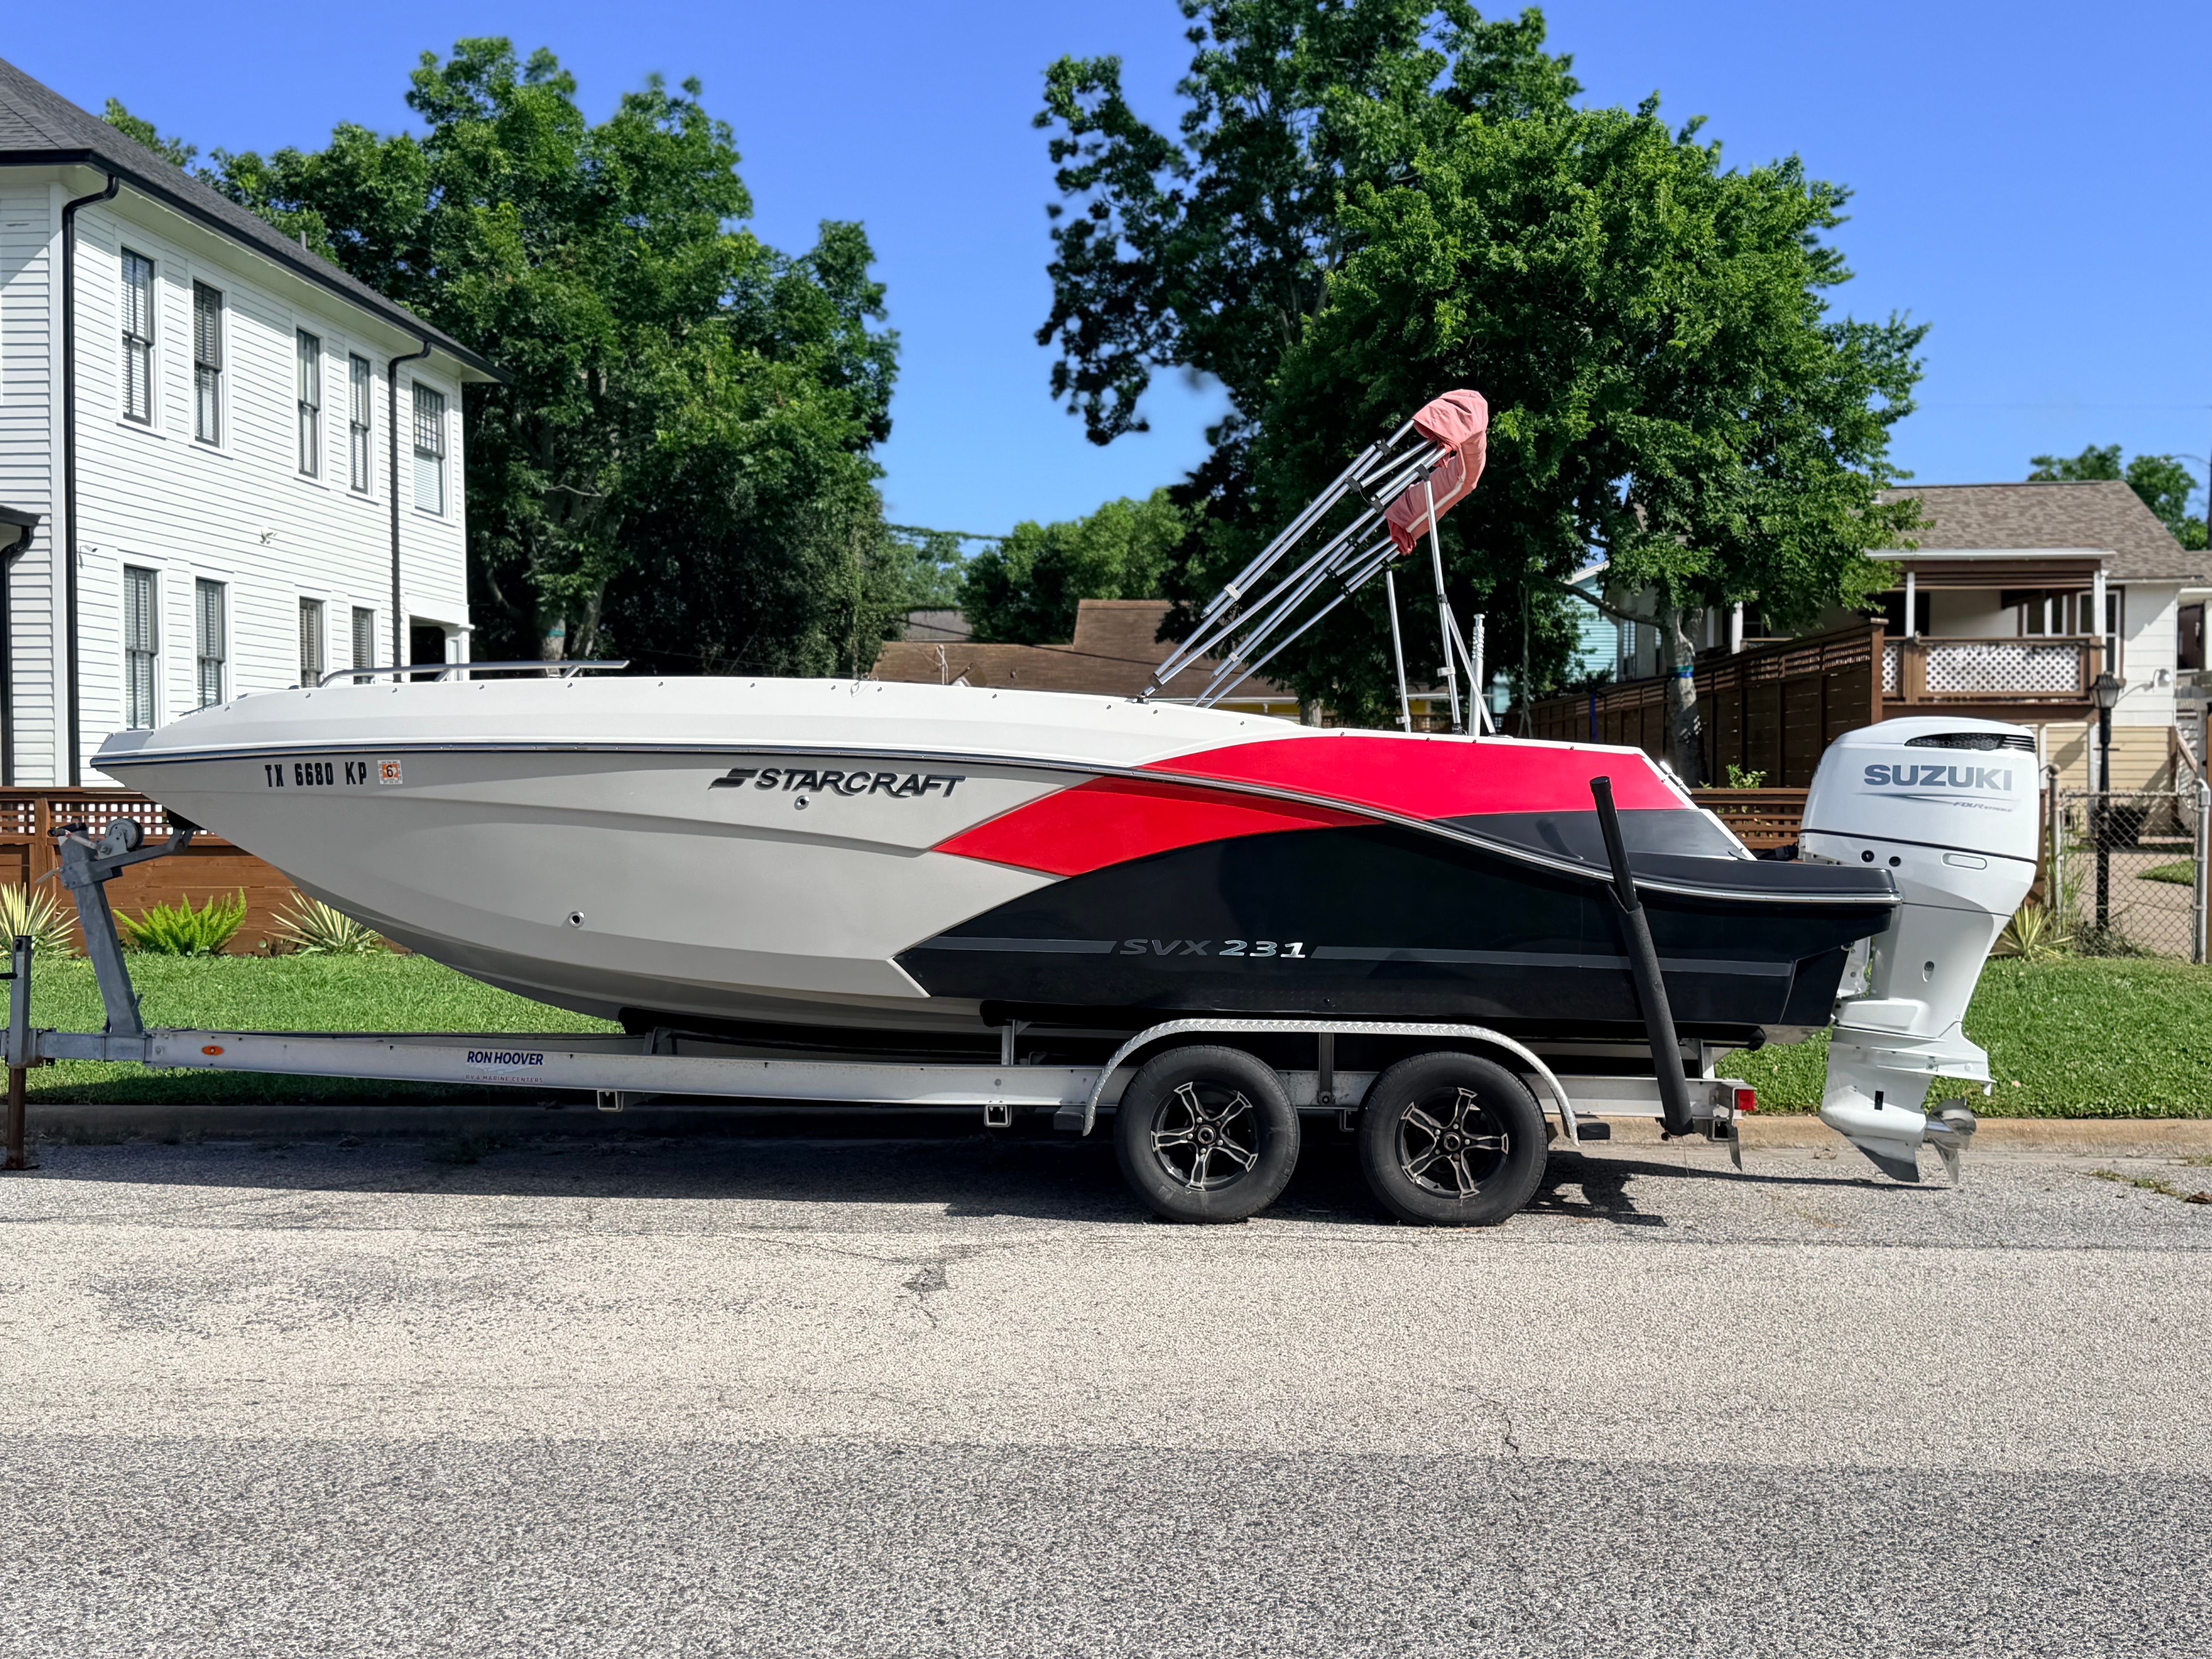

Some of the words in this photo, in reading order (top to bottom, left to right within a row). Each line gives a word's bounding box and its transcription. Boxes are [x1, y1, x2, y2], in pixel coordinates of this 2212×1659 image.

[265, 764, 284, 787] TX
[295, 763, 334, 786] 6680
[345, 761, 367, 785] KP
[386, 765, 393, 777] 6
[1864, 765, 2012, 791] SUZUKI
[756, 768, 966, 798] STARCRAFT
[1120, 939, 1211, 955] SVX
[1219, 940, 1306, 958] 231
[467, 1051, 493, 1063] RON
[494, 1052, 544, 1065] HOOVER
